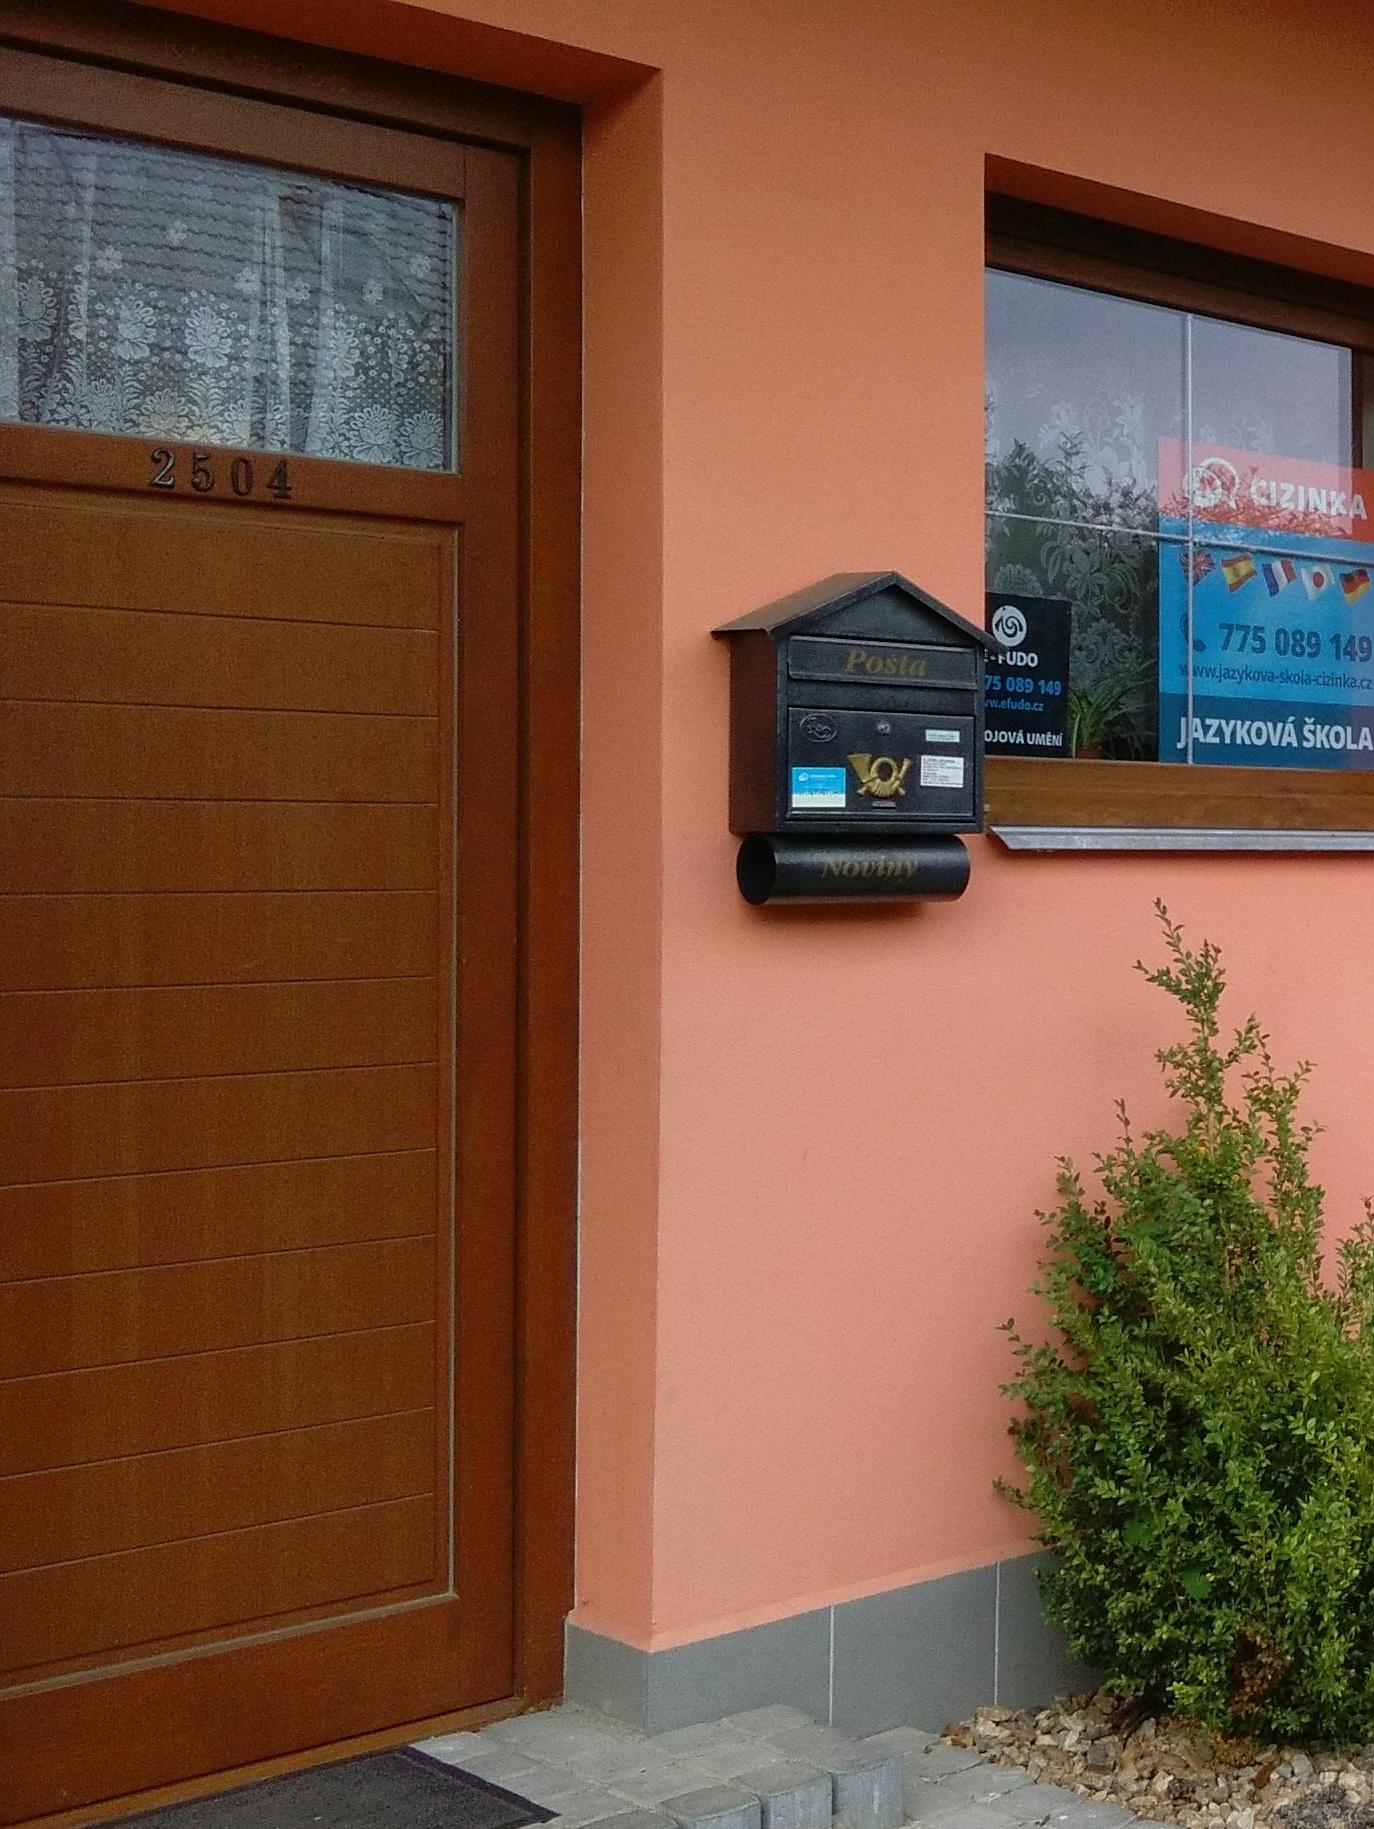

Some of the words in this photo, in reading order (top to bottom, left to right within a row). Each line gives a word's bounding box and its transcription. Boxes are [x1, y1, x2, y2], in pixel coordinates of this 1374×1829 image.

[150, 449, 292, 499] 2504
[1249, 477, 1368, 520] CIZINKA
[984, 648, 1039, 668] -FUDO
[1219, 622, 1266, 654] 775
[1275, 627, 1321, 658] 089
[1329, 633, 1372, 662] 149
[1006, 677, 1034, 693] 089
[1038, 680, 1062, 696] 149
[1027, 732, 1063, 747] UMĚNÍ
[1176, 716, 1298, 749] JAZYKOVÁ
[1302, 717, 1374, 751] ŠKOLA
